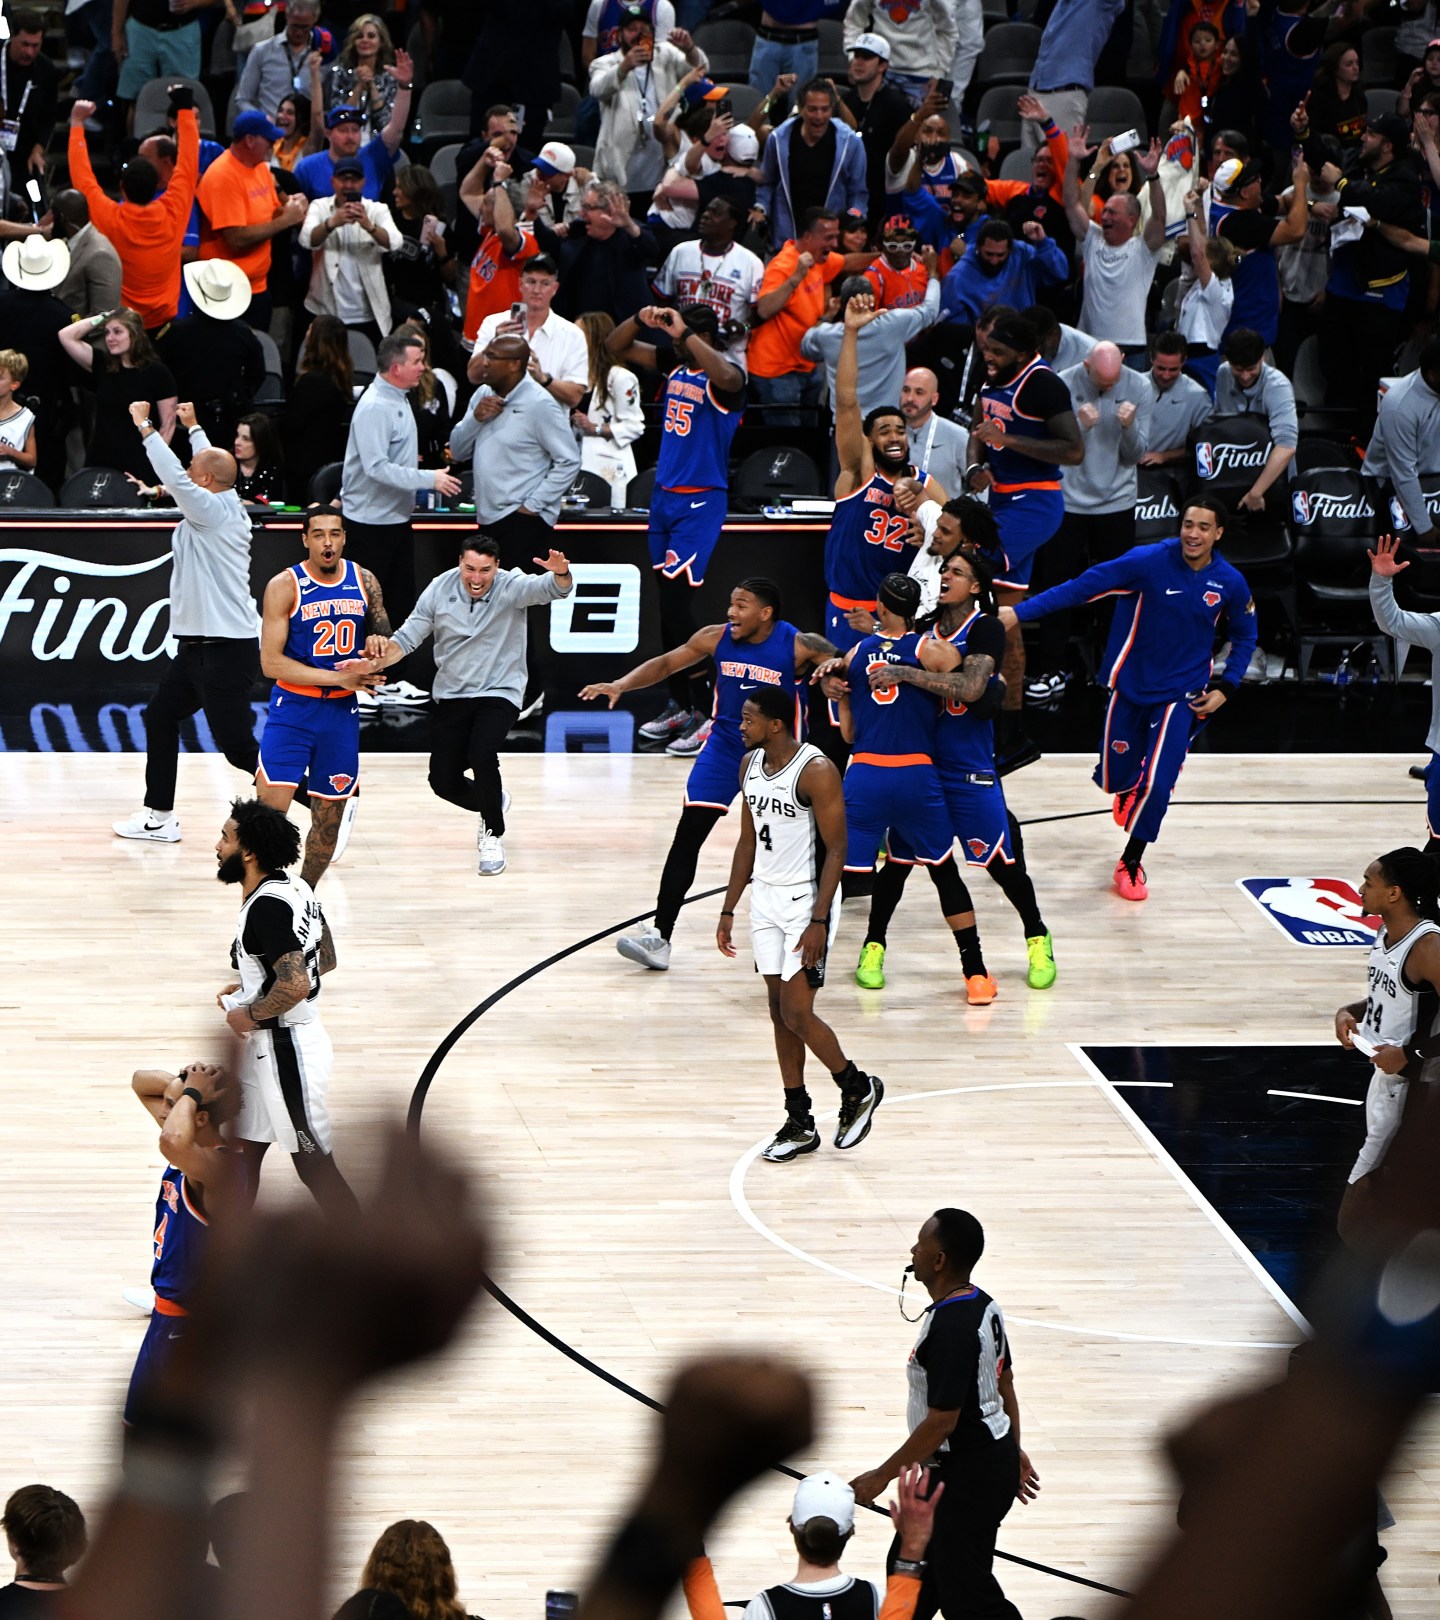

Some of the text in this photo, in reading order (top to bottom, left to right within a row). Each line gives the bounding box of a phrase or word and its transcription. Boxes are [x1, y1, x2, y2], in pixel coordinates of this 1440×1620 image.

[665, 398, 694, 437] 55
[1205, 441, 1272, 480] Final
[1135, 494, 1180, 520] nals
[1301, 493, 1375, 525] Finals
[864, 508, 909, 553] 32
[301, 599, 364, 621] NEW YORK
[313, 619, 356, 656] 20
[720, 661, 782, 686] NEW YORK
[744, 795, 796, 818] PURS
[759, 824, 772, 851] 4
[1301, 931, 1365, 944] NBA
[1367, 966, 1397, 998] PURS
